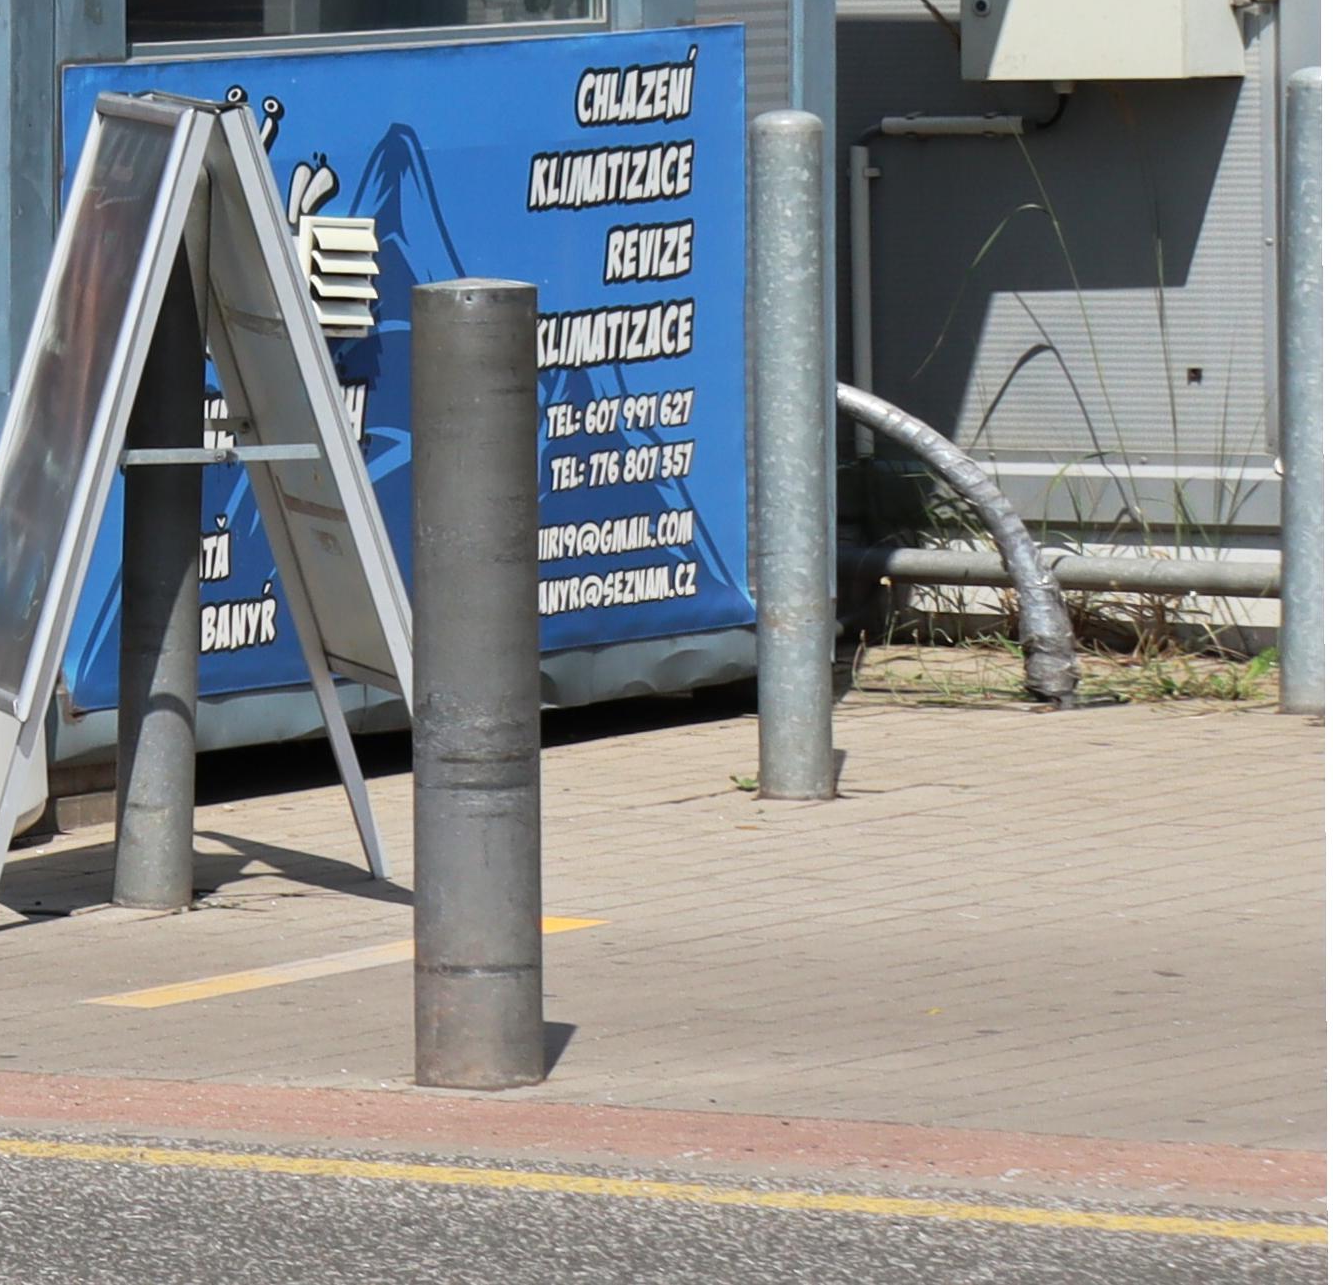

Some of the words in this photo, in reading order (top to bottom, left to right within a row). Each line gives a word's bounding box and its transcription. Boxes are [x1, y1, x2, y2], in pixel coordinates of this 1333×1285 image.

[577, 47, 698, 124] CHLAZENÍ
[529, 144, 693, 207] KLIMATIZACE
[605, 224, 693, 281] REVIZE
[537, 302, 693, 368] KLIMATIZACE
[547, 403, 582, 438] TEL:
[585, 398, 620, 434] 607
[551, 456, 586, 491] TEL:
